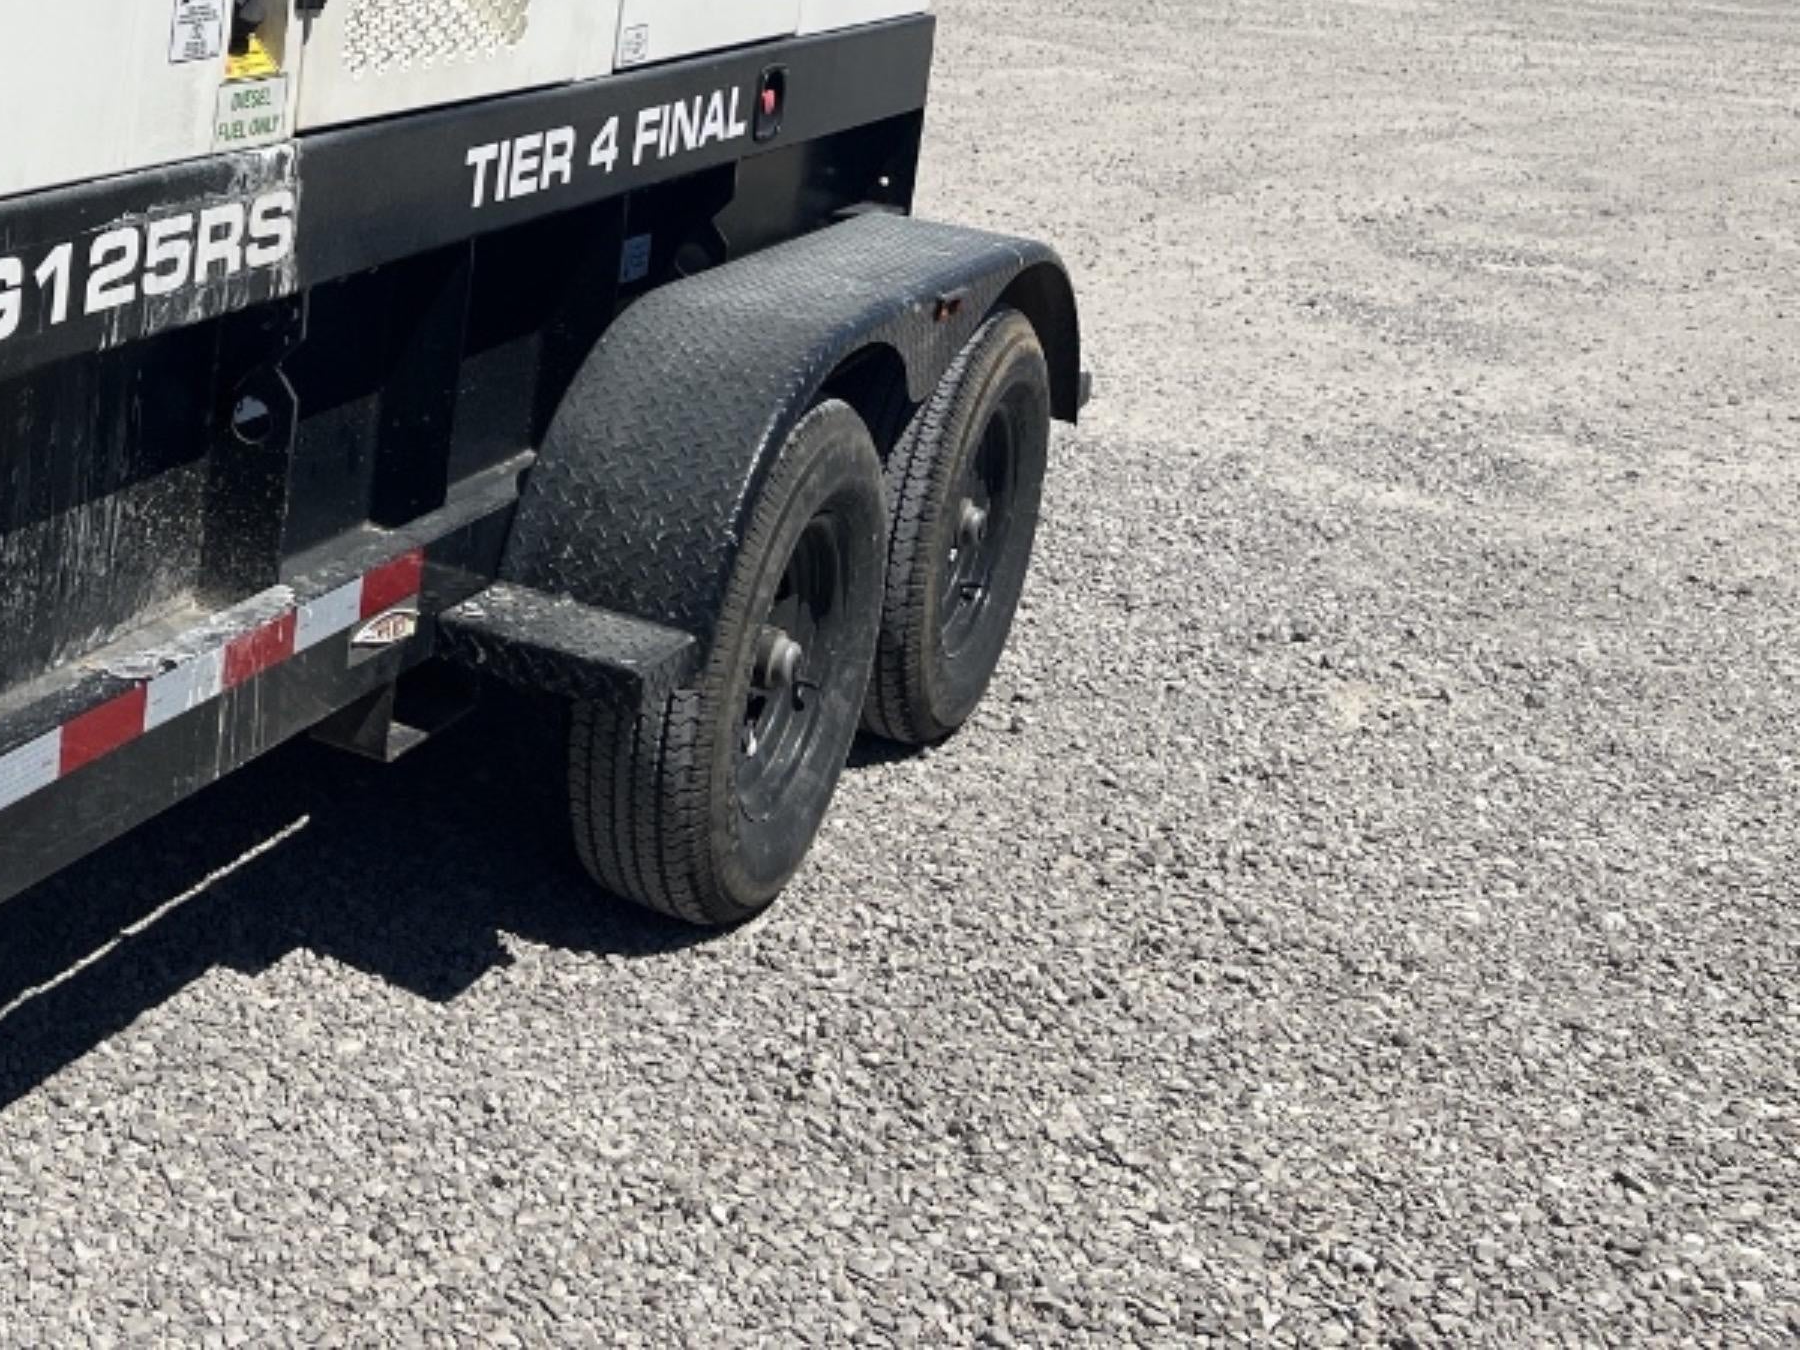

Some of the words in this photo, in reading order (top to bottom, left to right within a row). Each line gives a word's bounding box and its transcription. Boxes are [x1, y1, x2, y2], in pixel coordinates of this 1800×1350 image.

[231, 86, 271, 111] DIESEL
[218, 118, 246, 141] FUEL
[248, 114, 280, 137] ONLY
[465, 125, 576, 207] TIER
[589, 115, 619, 173] 4
[632, 86, 747, 166] FINAL
